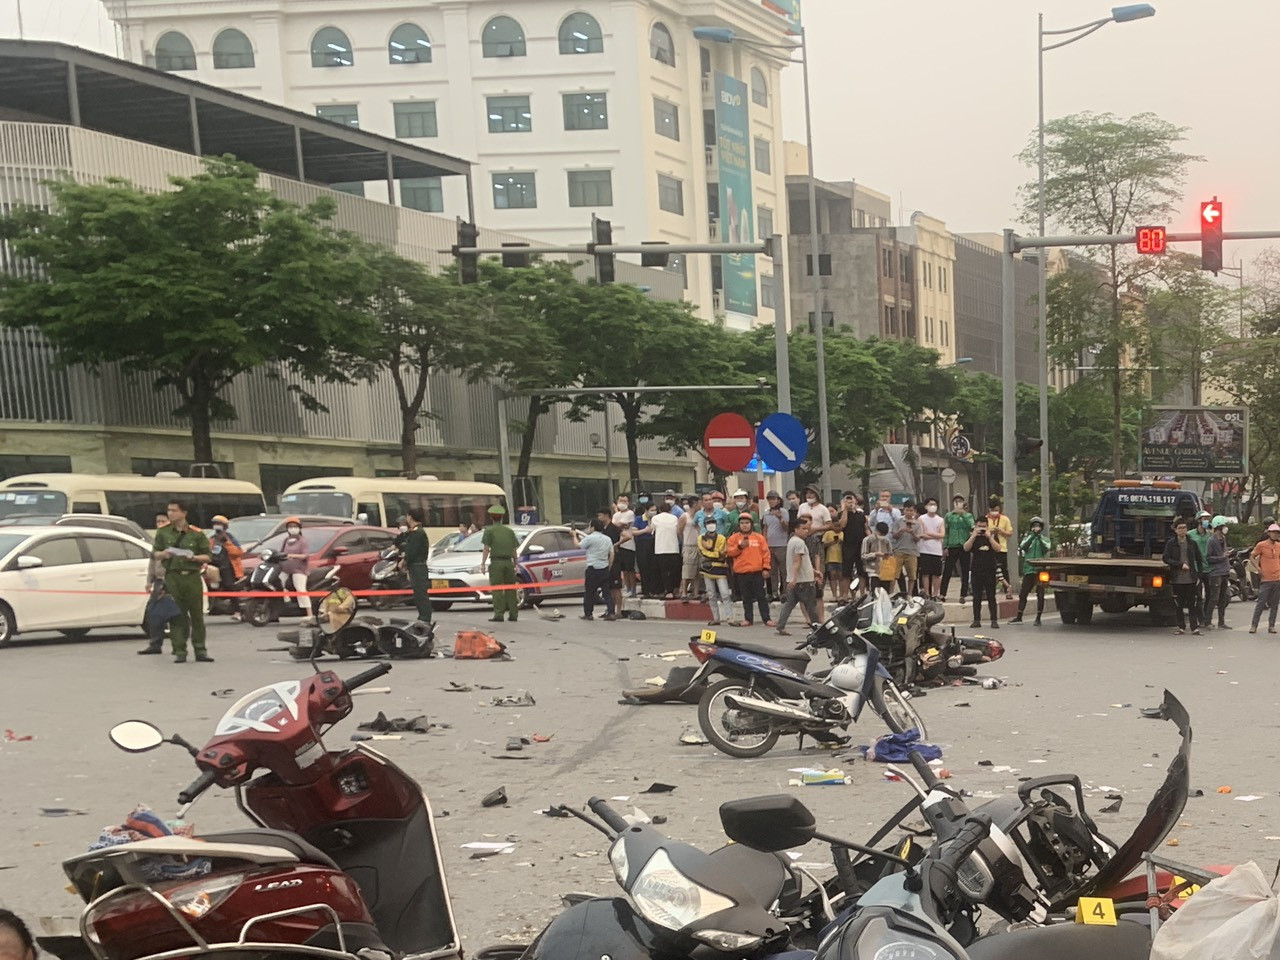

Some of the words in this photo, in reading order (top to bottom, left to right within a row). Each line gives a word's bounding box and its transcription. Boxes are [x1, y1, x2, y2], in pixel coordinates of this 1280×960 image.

[1139, 229, 1164, 251] 80
[255, 879, 303, 891] LEAD
[1092, 901, 1105, 919] 4
